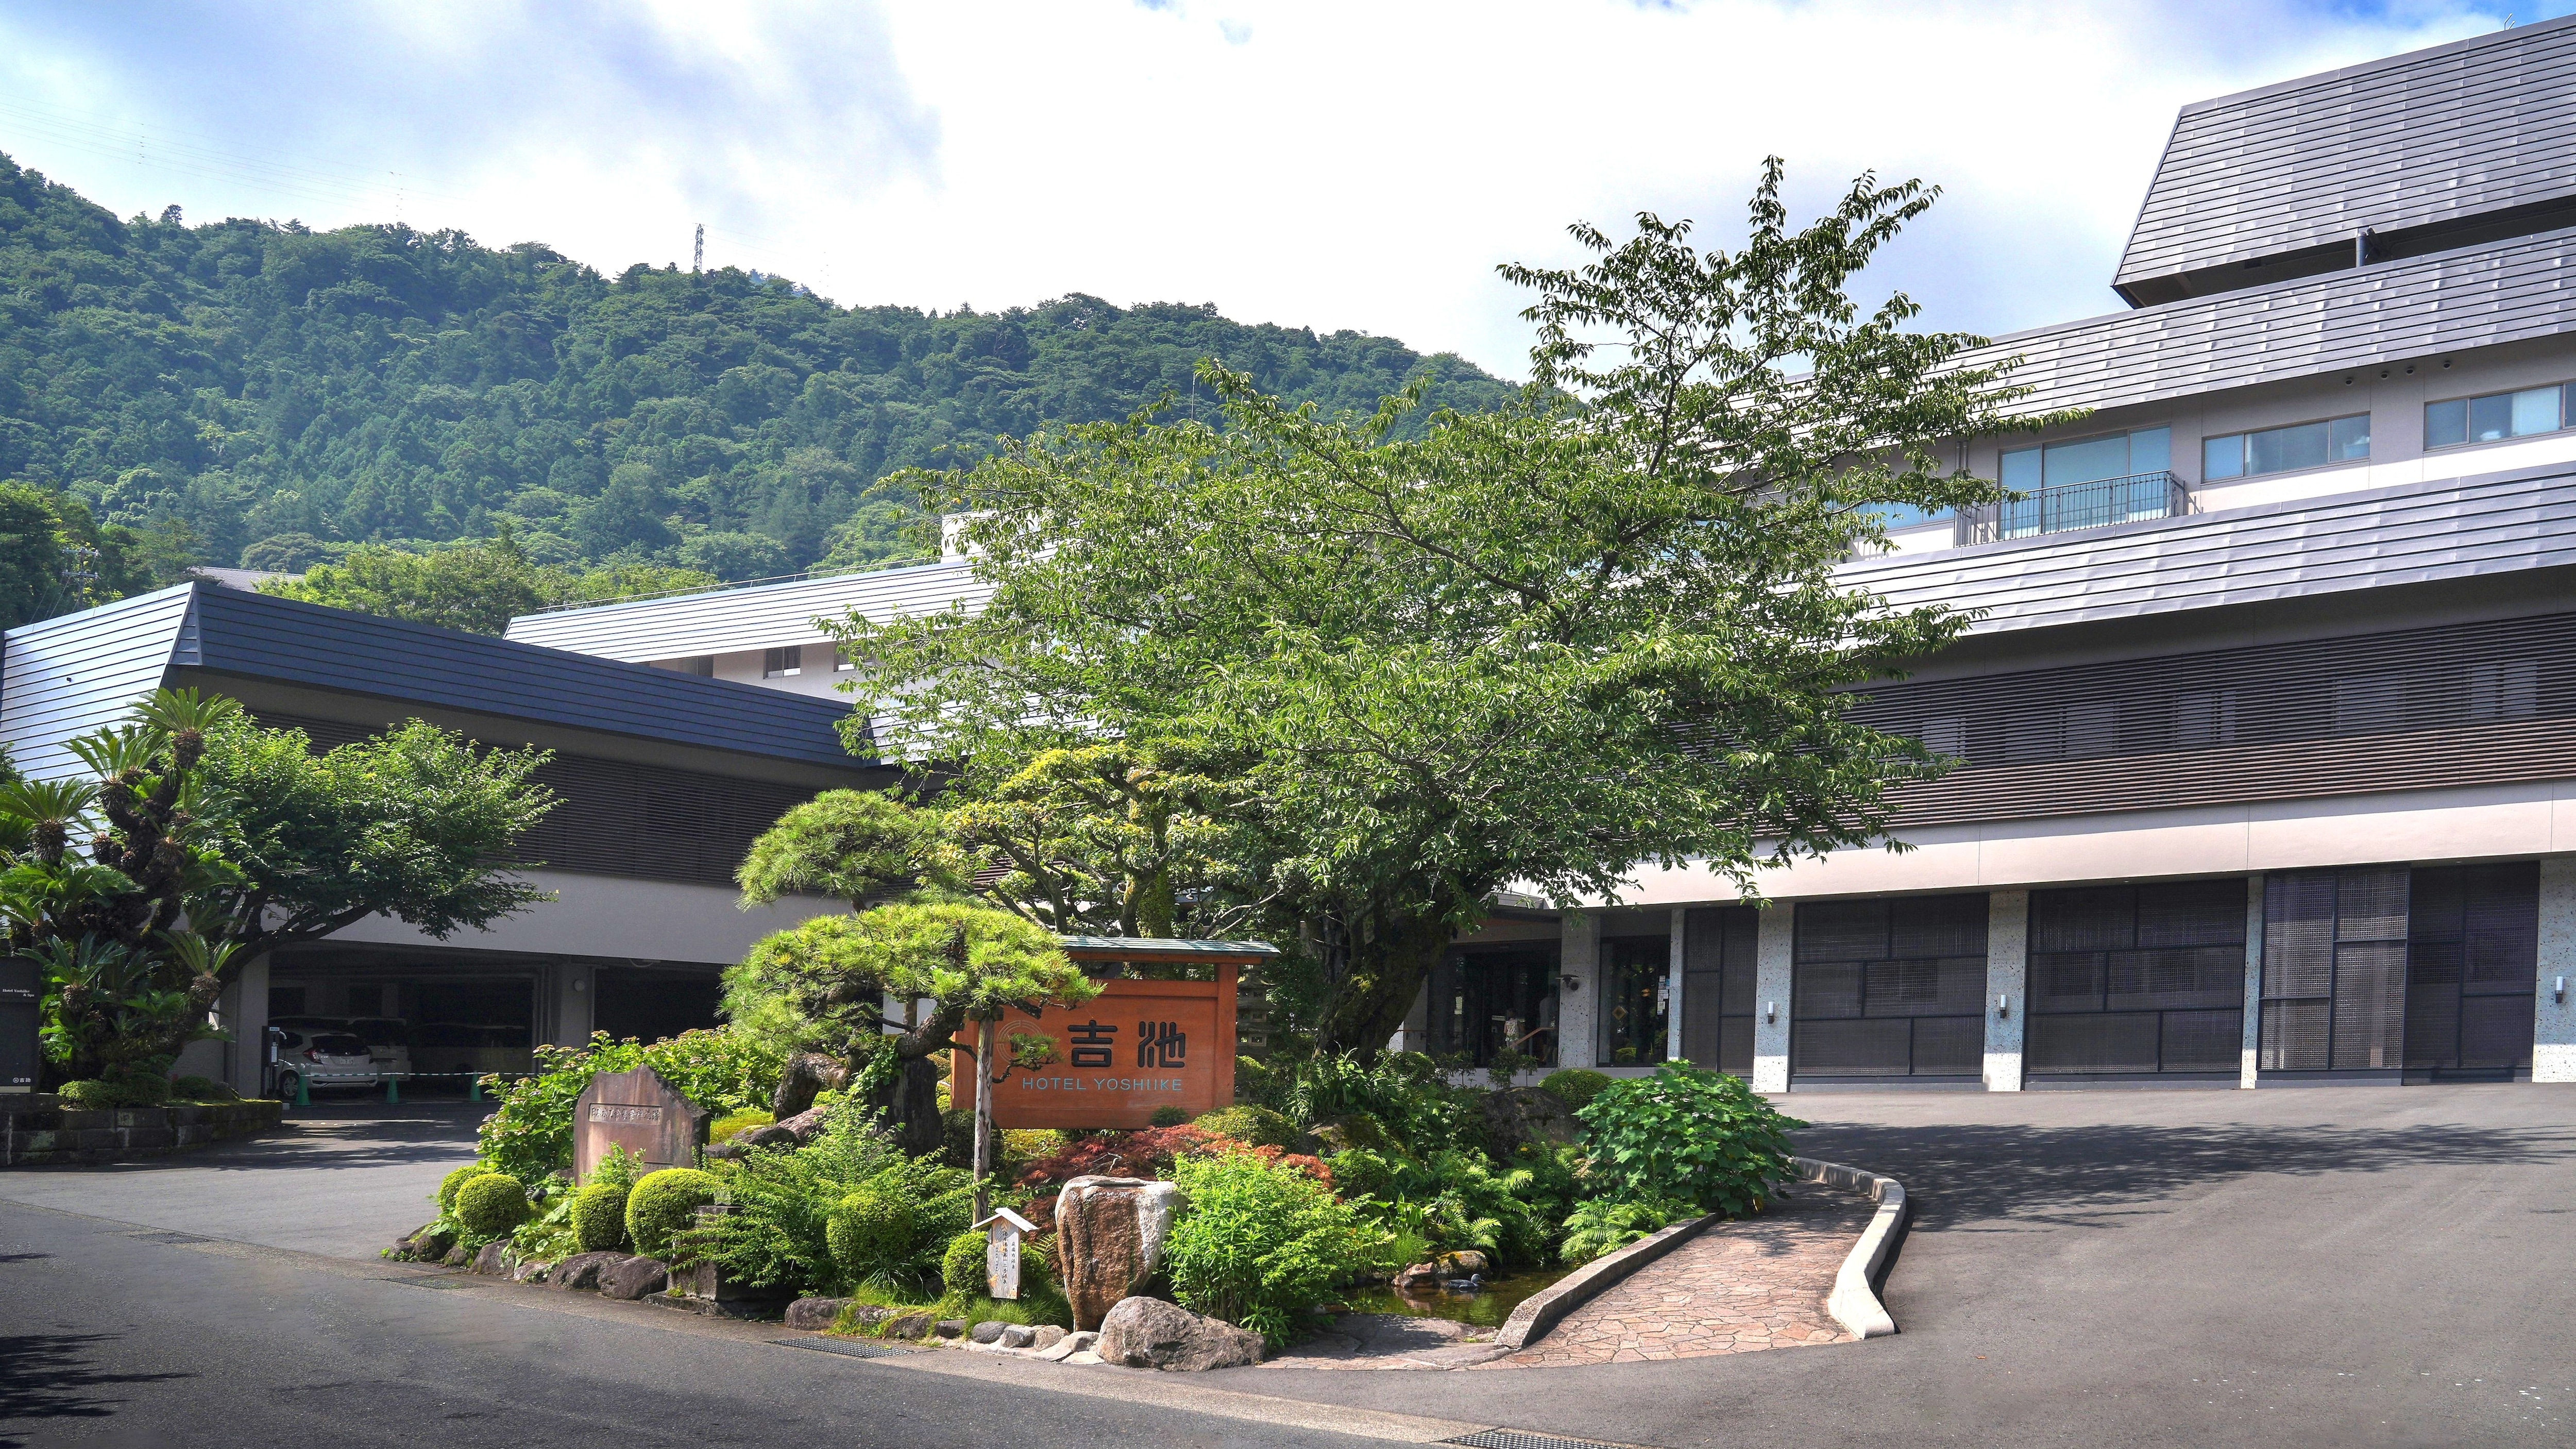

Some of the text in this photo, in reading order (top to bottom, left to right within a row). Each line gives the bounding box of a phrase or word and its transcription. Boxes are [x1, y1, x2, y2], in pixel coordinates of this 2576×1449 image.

[1067, 1019, 1186, 1068] 吉池
[1022, 1077, 1183, 1091] HOTEL YOSHIIKE
